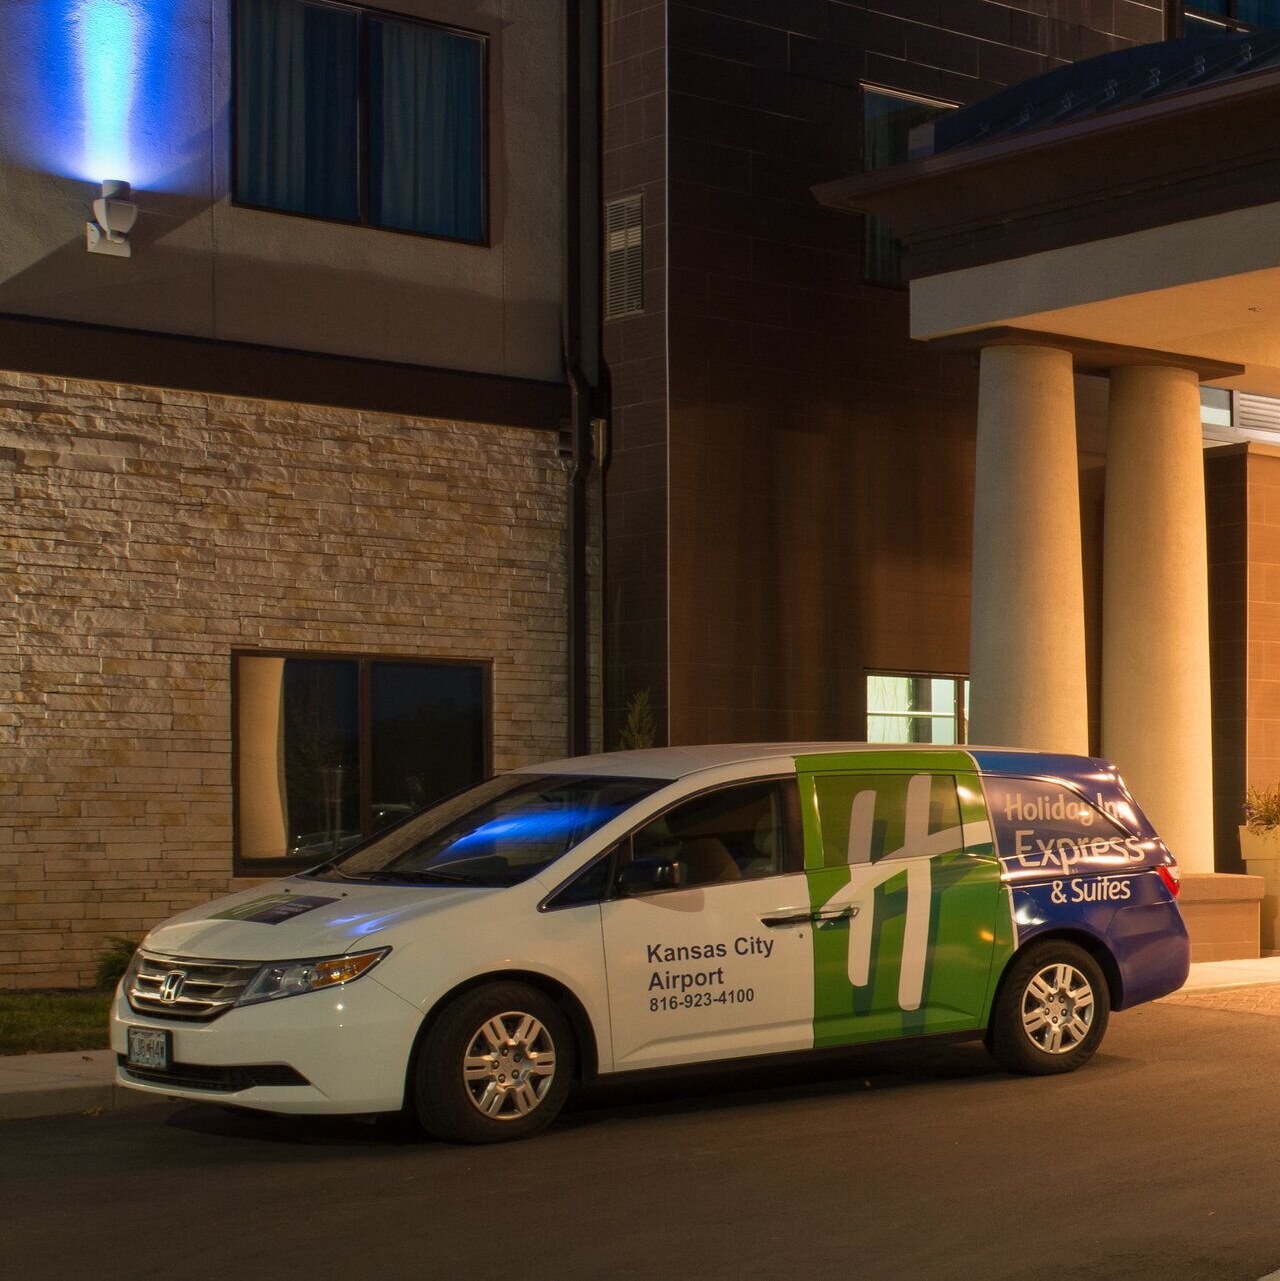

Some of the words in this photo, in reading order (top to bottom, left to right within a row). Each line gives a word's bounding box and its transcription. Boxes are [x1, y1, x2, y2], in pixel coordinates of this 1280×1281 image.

[1004, 792, 1094, 827] Holiday
[1015, 829, 1146, 876] Express
[1050, 880, 1068, 905] &
[1070, 877, 1132, 903] Suites
[646, 943, 727, 964] Kansas
[734, 936, 775, 959] City
[647, 967, 724, 993] Airport
[649, 988, 755, 1012] 816-923-4100
